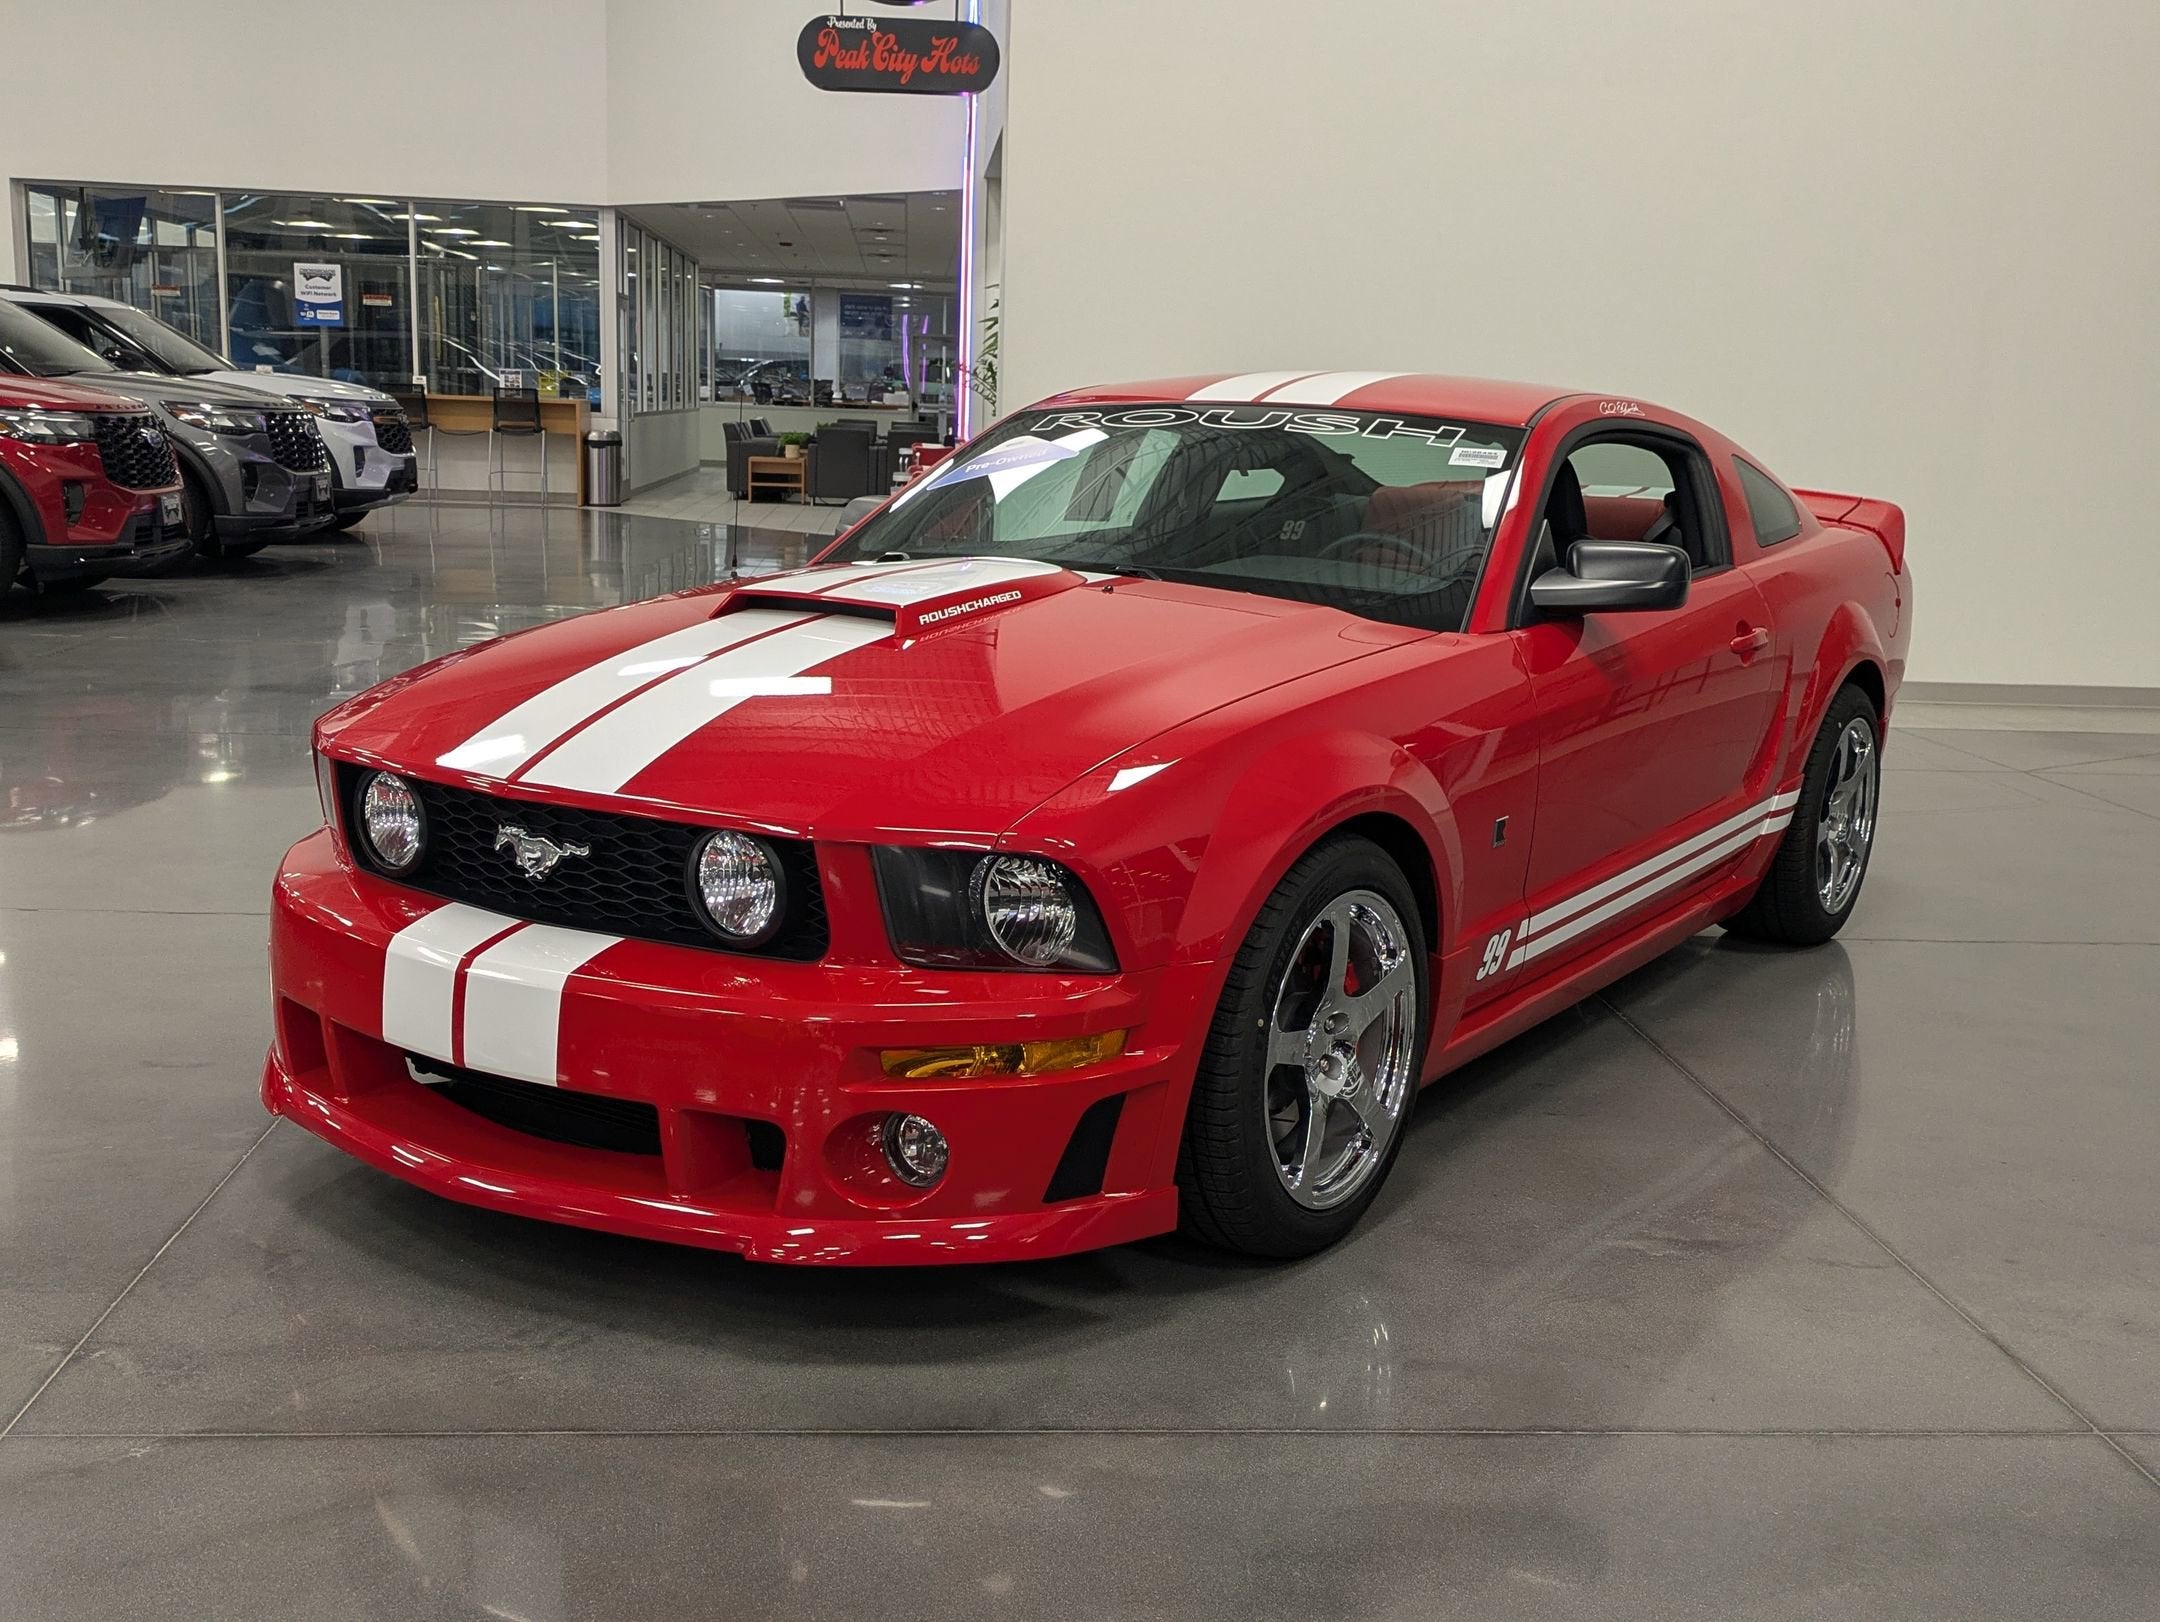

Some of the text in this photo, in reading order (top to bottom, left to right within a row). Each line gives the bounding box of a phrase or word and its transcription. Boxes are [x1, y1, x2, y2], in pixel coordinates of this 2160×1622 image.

[827, 16, 877, 33] Presented By
[814, 28, 981, 85] Peak City Hots
[1031, 409, 1468, 448] ROUSH
[965, 447, 1048, 473] Pre-Owned
[1280, 520, 1306, 540] 99
[918, 590, 1022, 625] ROUSHCHARGED
[1476, 928, 1512, 981] 99
